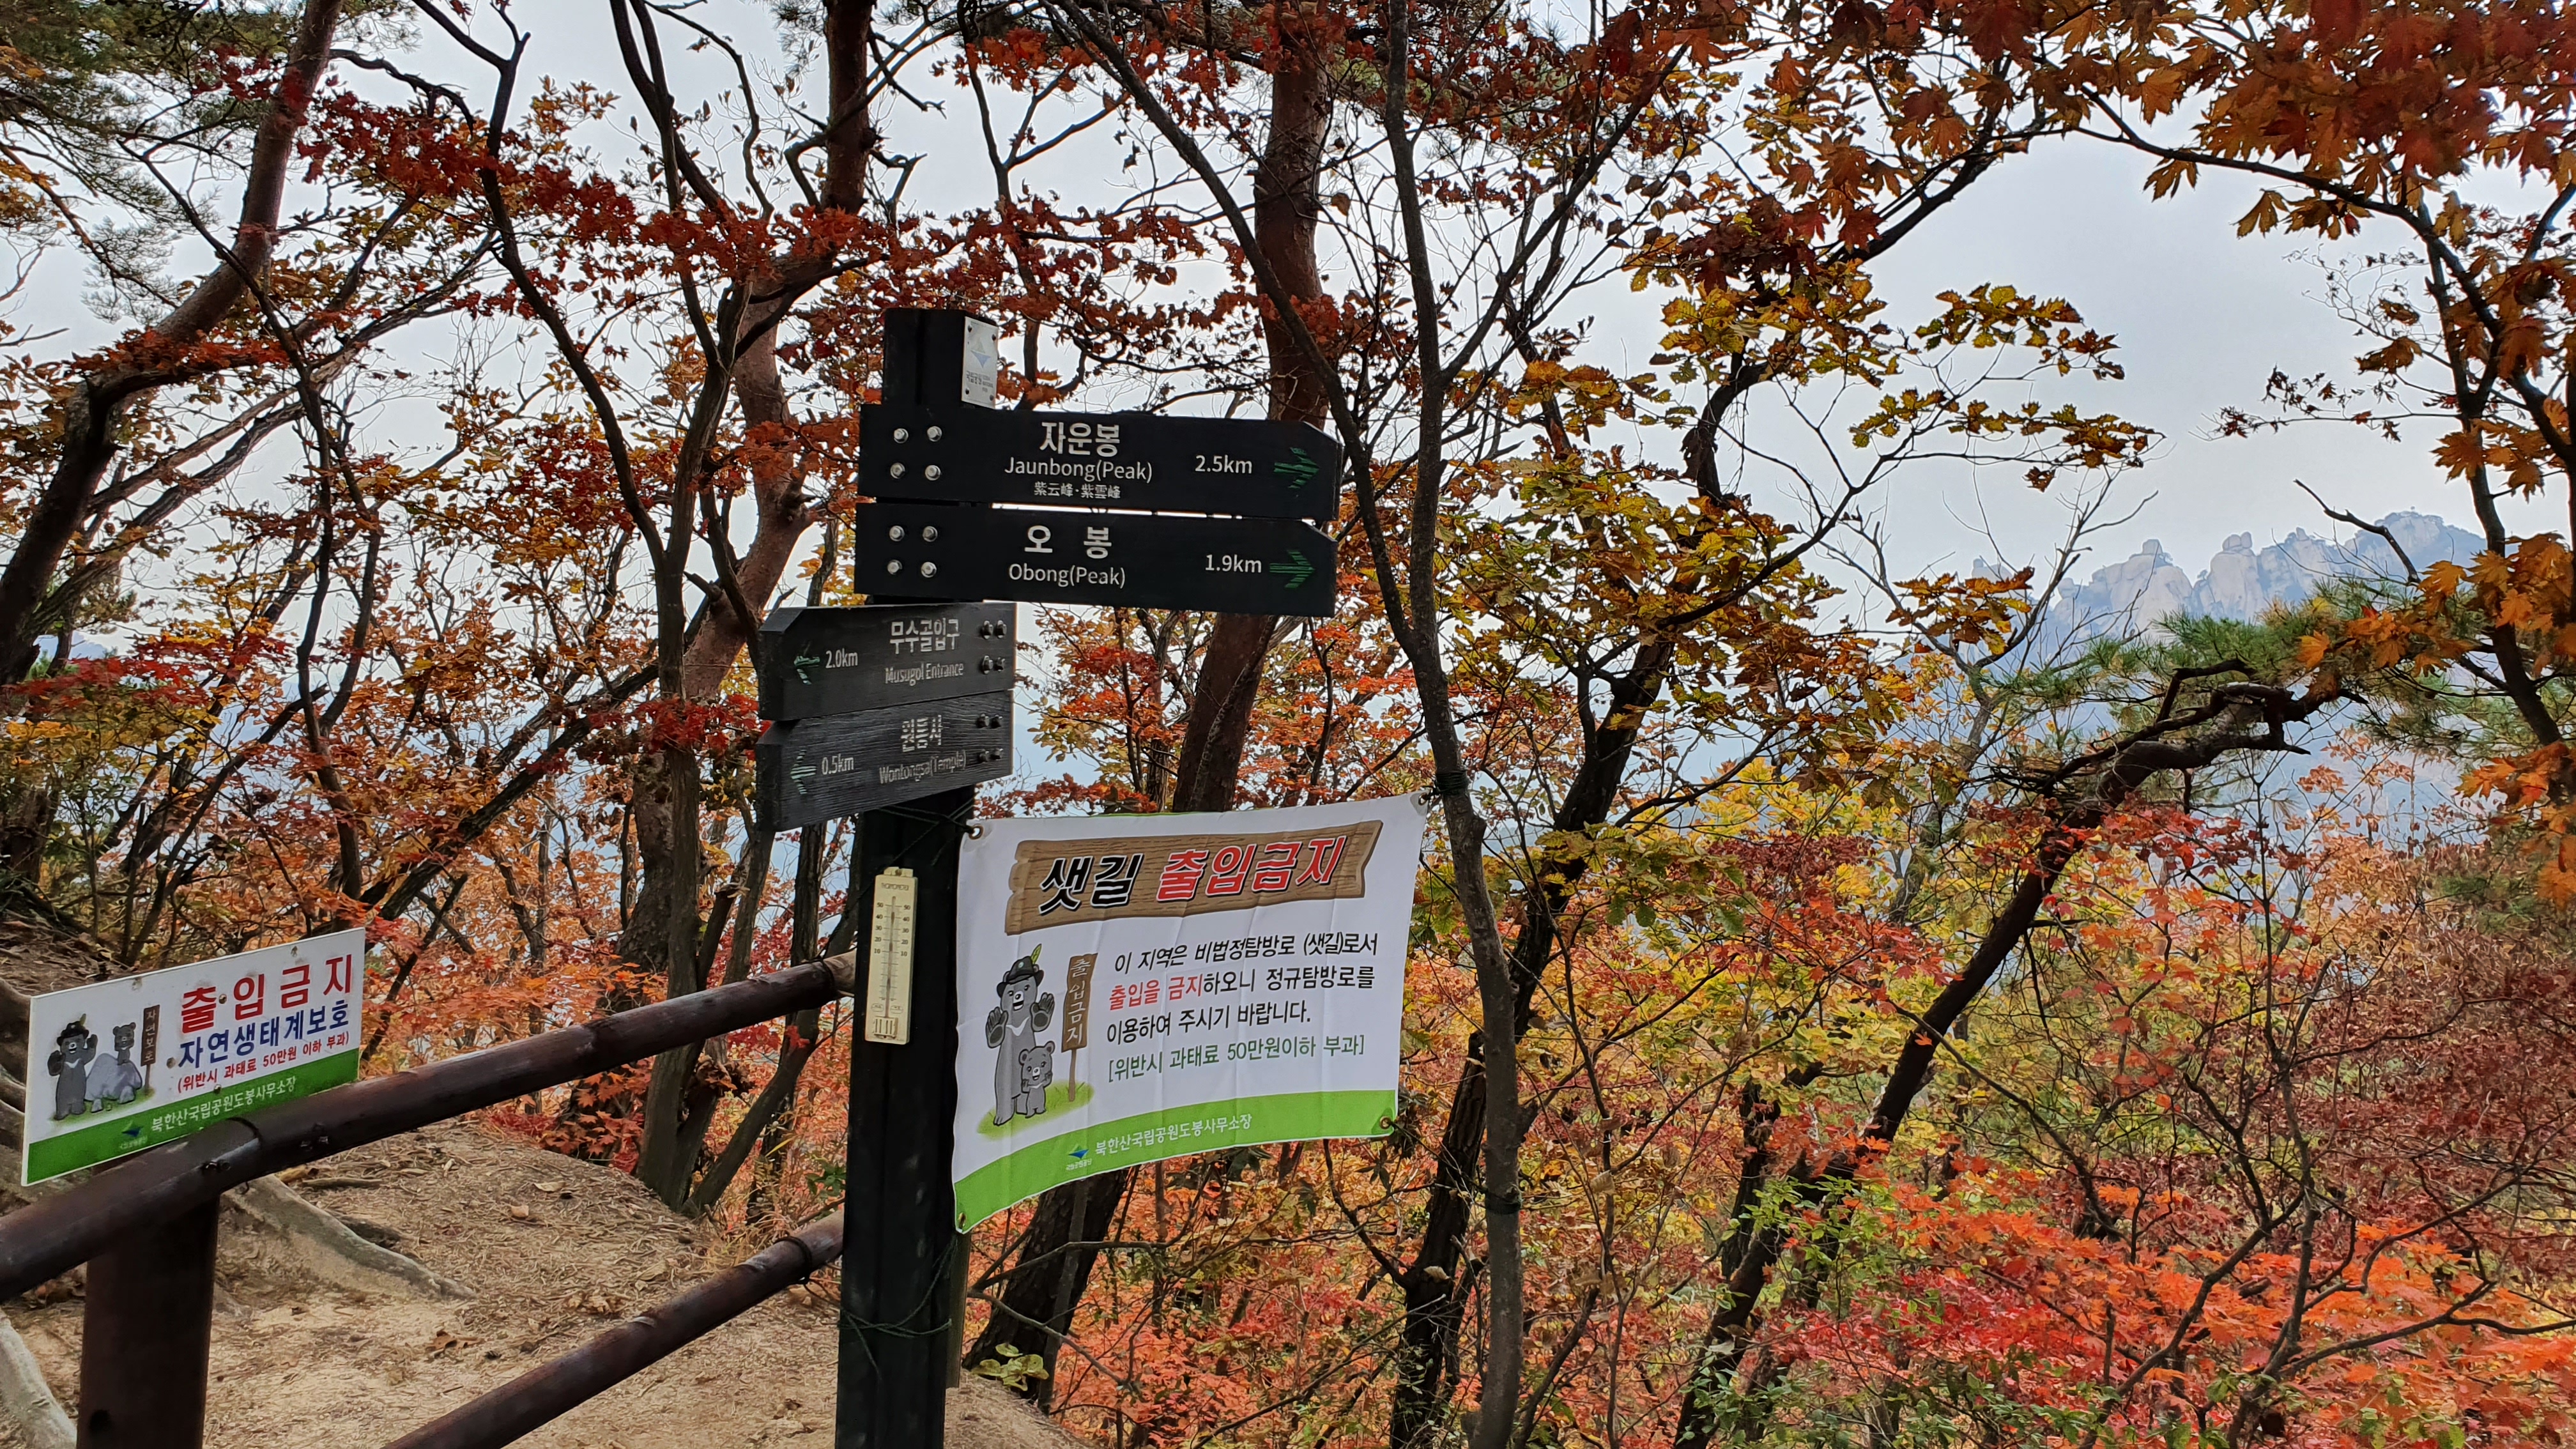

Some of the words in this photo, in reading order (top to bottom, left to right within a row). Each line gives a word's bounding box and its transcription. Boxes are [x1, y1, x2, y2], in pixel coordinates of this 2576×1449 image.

[1039, 422, 1121, 457] 자운봉
[1004, 456, 1153, 484] Jaunbong(Peak)
[1194, 454, 1253, 474] 2.5km
[1008, 563, 1126, 589] Obong(Peak)
[1204, 553, 1262, 574] 1.9km
[889, 617, 960, 655] 무수골입구
[825, 648, 859, 669] 2.0km
[884, 663, 924, 686] Musugol
[925, 663, 965, 680] Entrance
[821, 753, 854, 776] 0.5km
[1038, 853, 1144, 916] 샛길
[1156, 835, 1347, 902] 출입금지
[1114, 951, 1133, 975] 이
[1137, 944, 1188, 972] 지역은
[1194, 935, 1296, 964] 비법정탐방로
[1303, 931, 1379, 957] (샛길)로서
[1066, 958, 1092, 1046] 출입금지
[1108, 978, 1161, 1011] 출입을
[1168, 968, 1256, 1001] 금지하오니
[1266, 965, 1376, 992] 정규탐방로를
[178, 999, 349, 1069] 자연생태계보호
[1106, 1011, 1172, 1046] 이용하여
[1177, 1004, 1231, 1035] 주시기
[1237, 999, 1311, 1026] 바랍니다.
[177, 1068, 218, 1094] (위반시
[224, 1057, 257, 1080] 과태료
[263, 1045, 297, 1068] 50만원
[302, 1038, 323, 1056] 이하
[326, 1031, 350, 1048] 부과)
[1108, 1050, 1163, 1083] [위반시
[1169, 1043, 1220, 1070] 과태료
[1226, 1034, 1317, 1062] 50만원이하
[1322, 1034, 1365, 1057] 부과]
[151, 1076, 297, 1133] 북한산국립공원도봉사무소장
[1094, 1113, 1253, 1156] 북한산국립공원도봉사무소장
